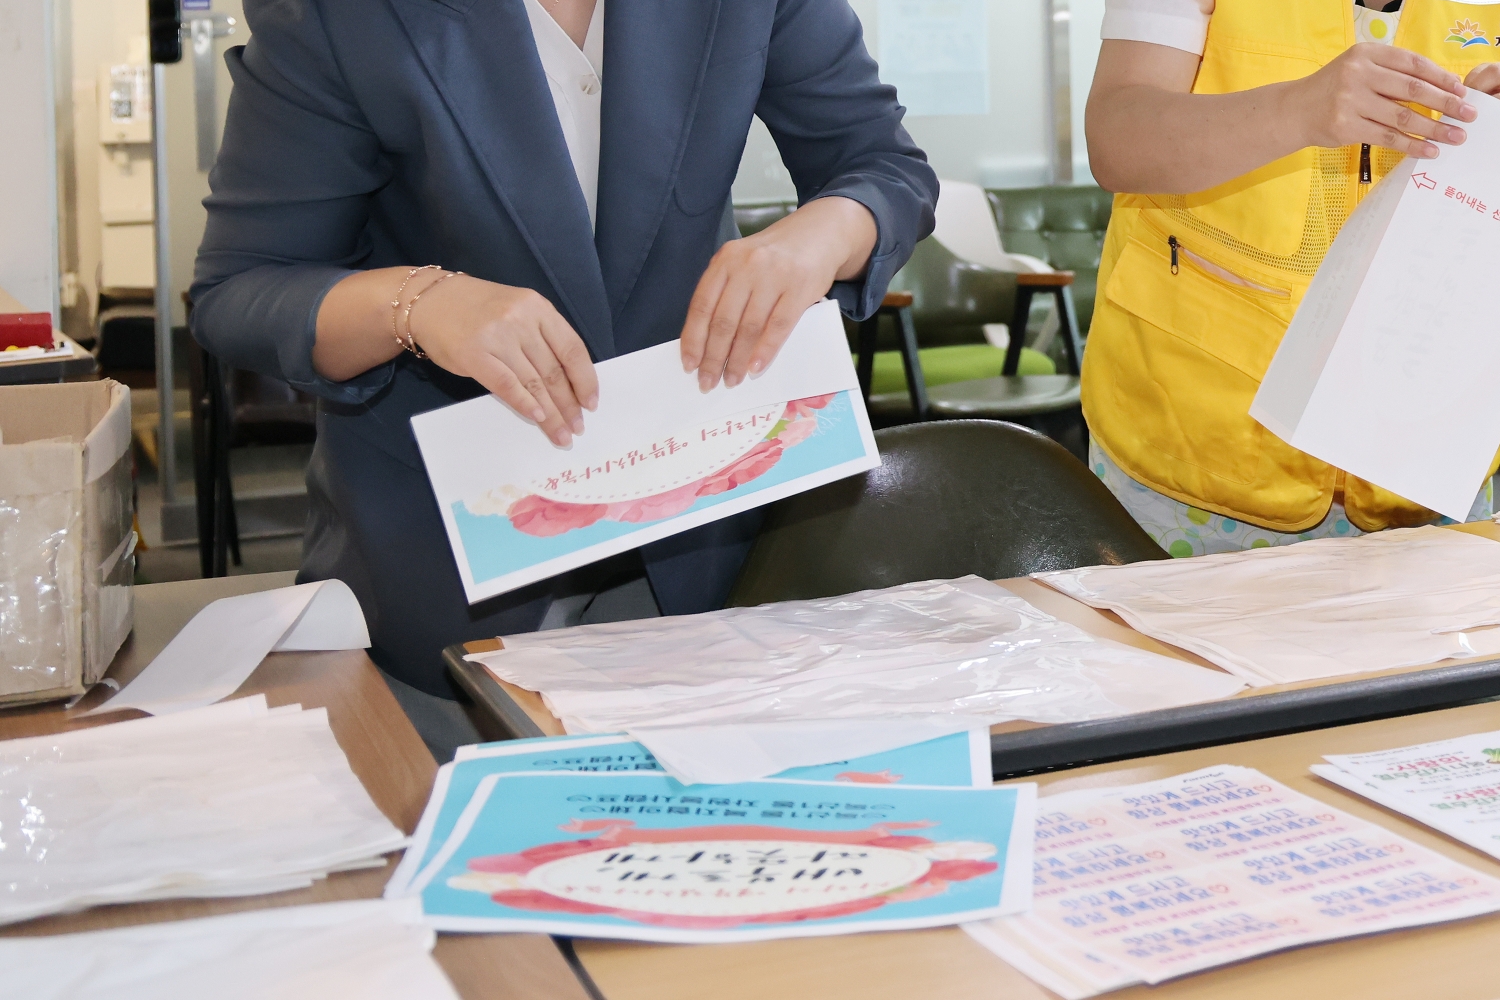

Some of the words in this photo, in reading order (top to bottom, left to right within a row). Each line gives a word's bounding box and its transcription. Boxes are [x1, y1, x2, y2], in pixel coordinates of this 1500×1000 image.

[701, 411, 777, 442] 사랑의
[1390, 755, 1466, 772] 사랑의
[1172, 779, 1246, 795] 드시고
[1026, 811, 1076, 826] 시고
[1232, 807, 1305, 825] 드시고
[1027, 820, 1096, 839] 하세요
